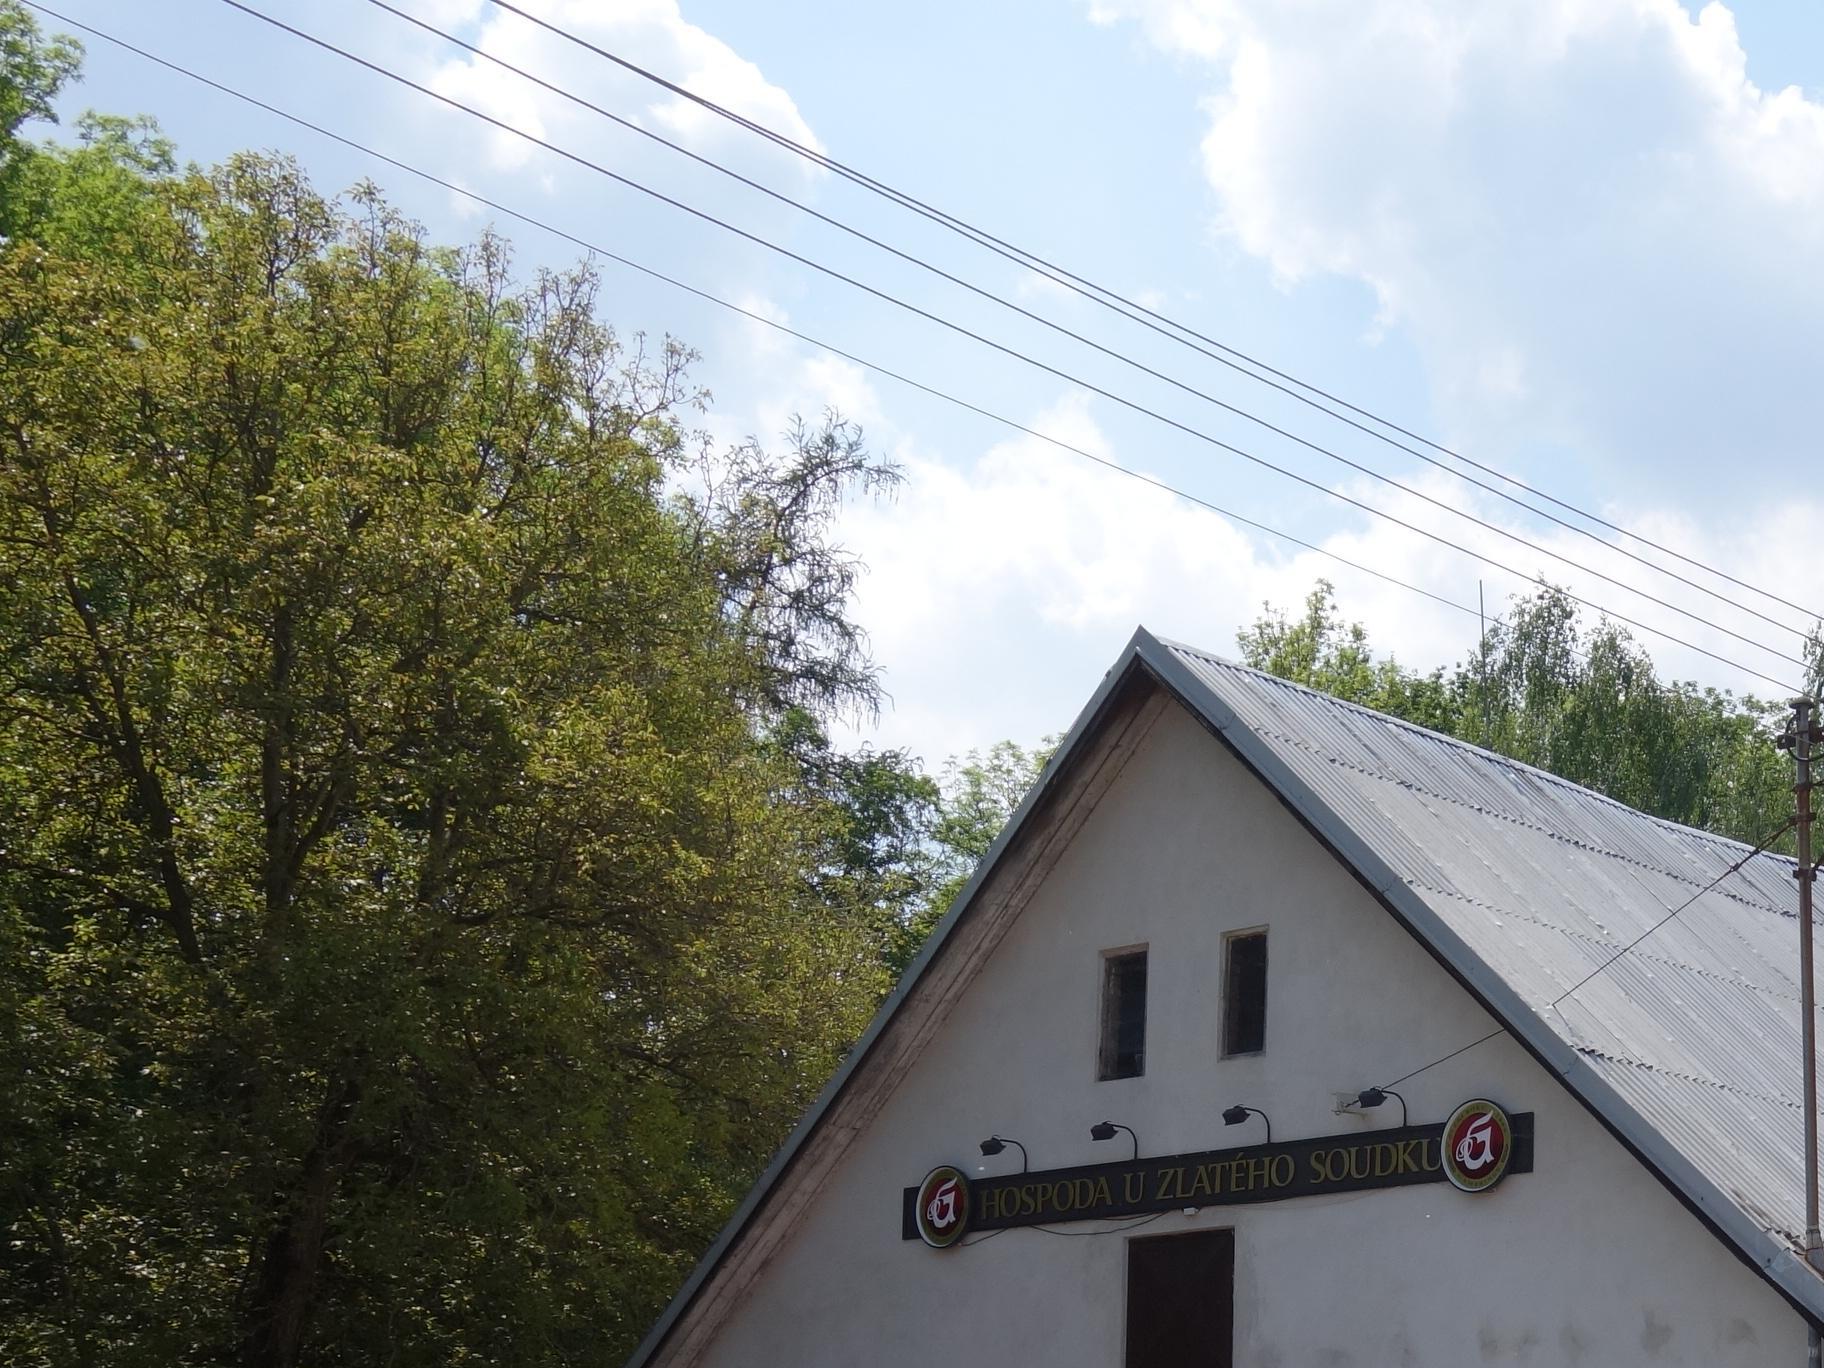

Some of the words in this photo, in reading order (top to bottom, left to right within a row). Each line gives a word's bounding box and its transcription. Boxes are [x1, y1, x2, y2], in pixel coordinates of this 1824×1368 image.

[980, 1175, 1113, 1220] HOSPODA
[1123, 1171, 1146, 1204] U
[1155, 1152, 1295, 1201] ZLATÉHO
[1309, 1136, 1441, 1184] SOUDKU
